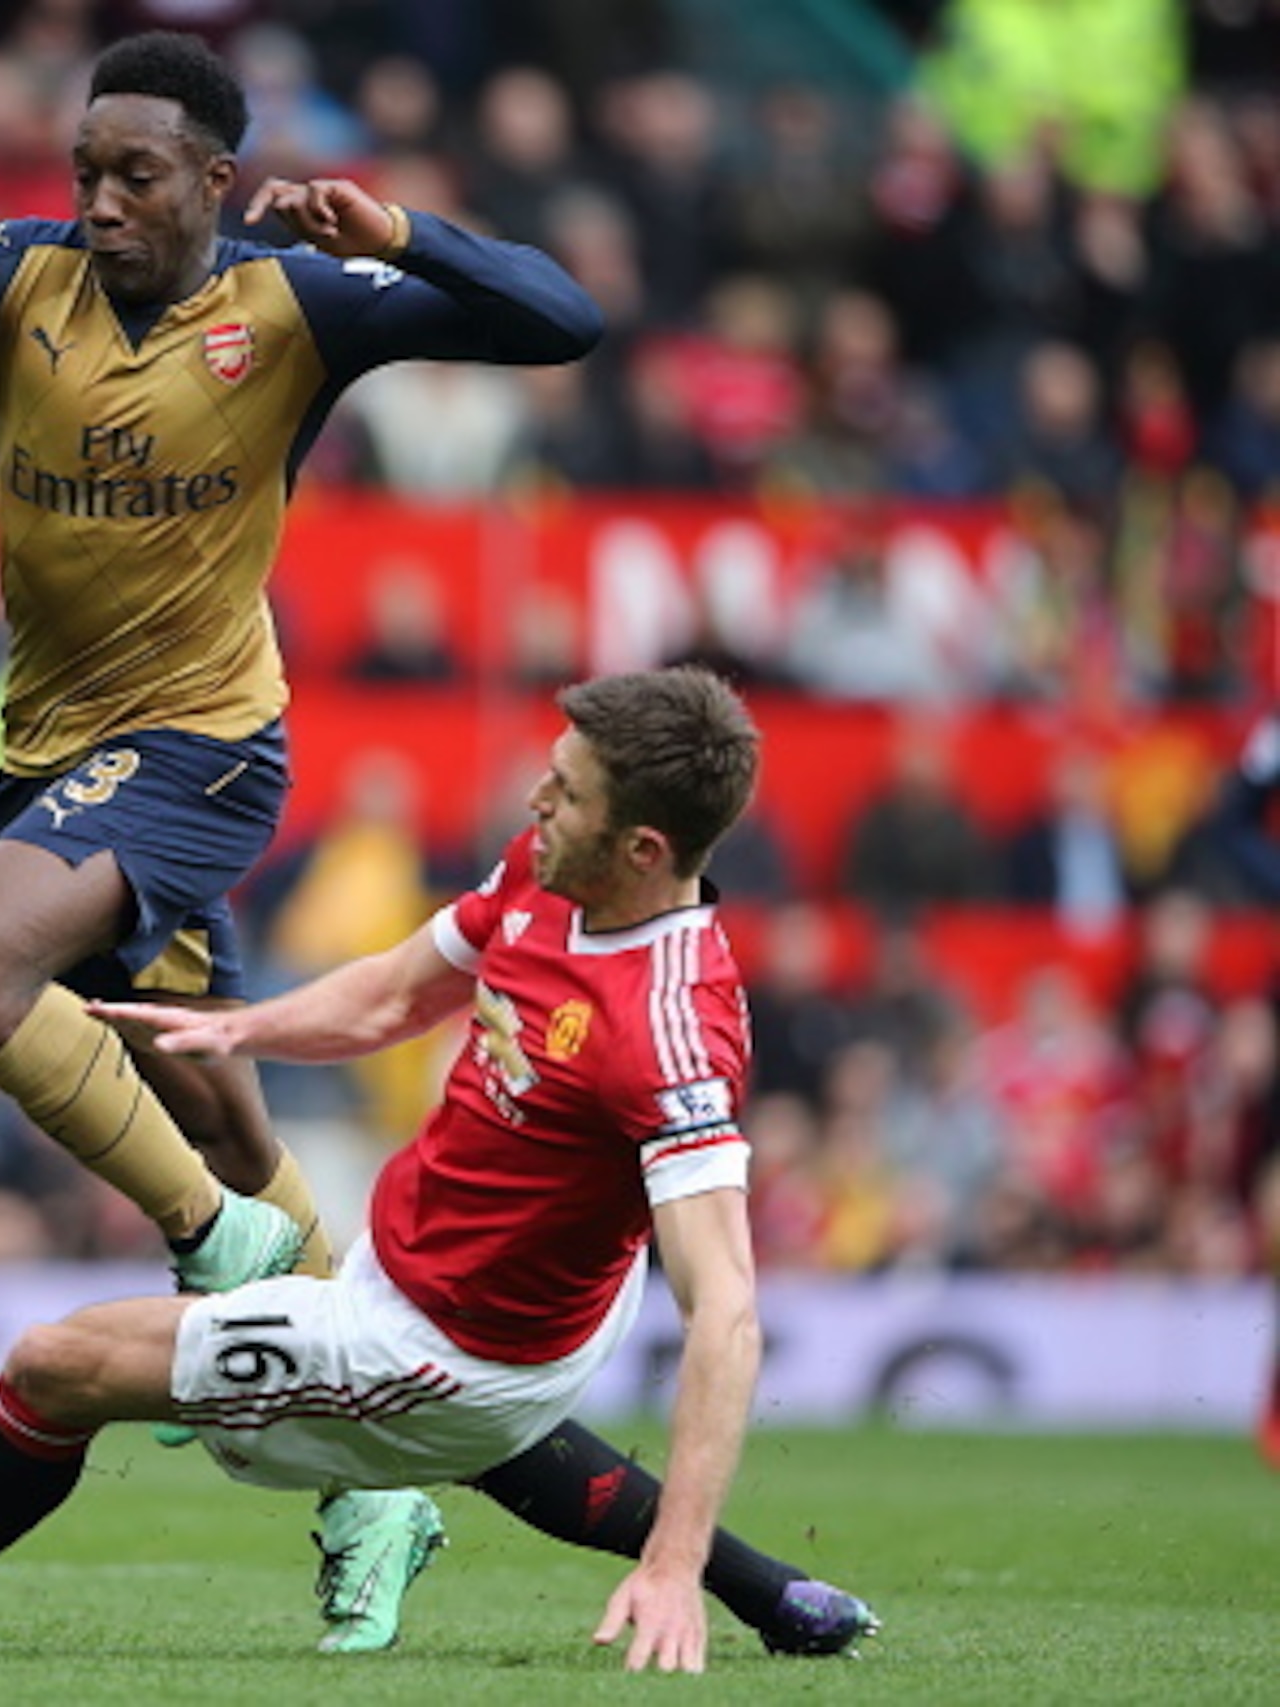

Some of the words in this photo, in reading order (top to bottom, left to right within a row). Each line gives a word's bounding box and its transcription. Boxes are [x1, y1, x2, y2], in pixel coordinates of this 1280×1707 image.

[79, 425, 155, 467] Fly
[10, 443, 239, 517] Emirates
[47, 748, 141, 804] 3
[211, 1313, 296, 1383] 16
